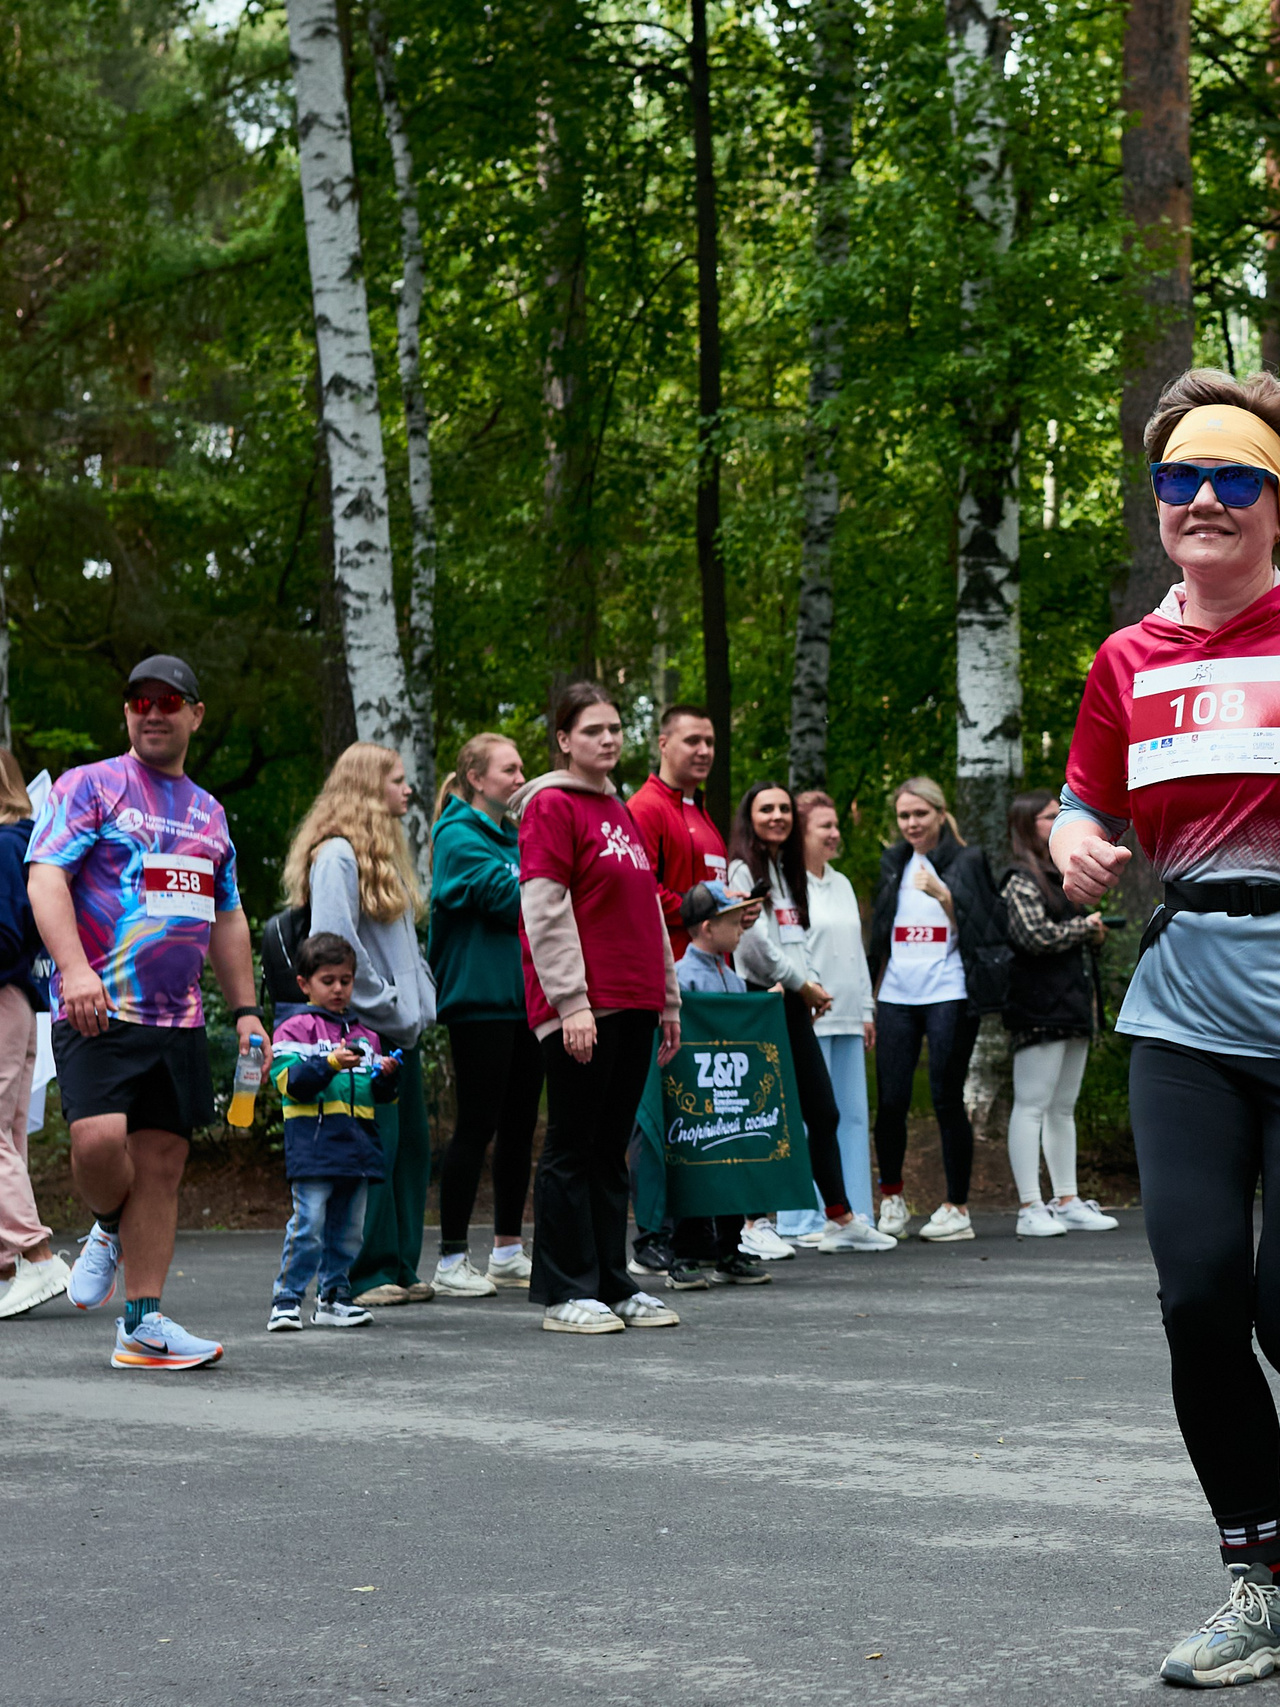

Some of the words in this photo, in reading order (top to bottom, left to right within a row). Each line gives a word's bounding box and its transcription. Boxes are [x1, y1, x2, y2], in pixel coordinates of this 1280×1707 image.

[1169, 689, 1246, 728] 108
[165, 869, 201, 893] 258
[905, 927, 934, 942] 223
[693, 1052, 749, 1088] Z&P
[744, 1107, 780, 1132] состав
